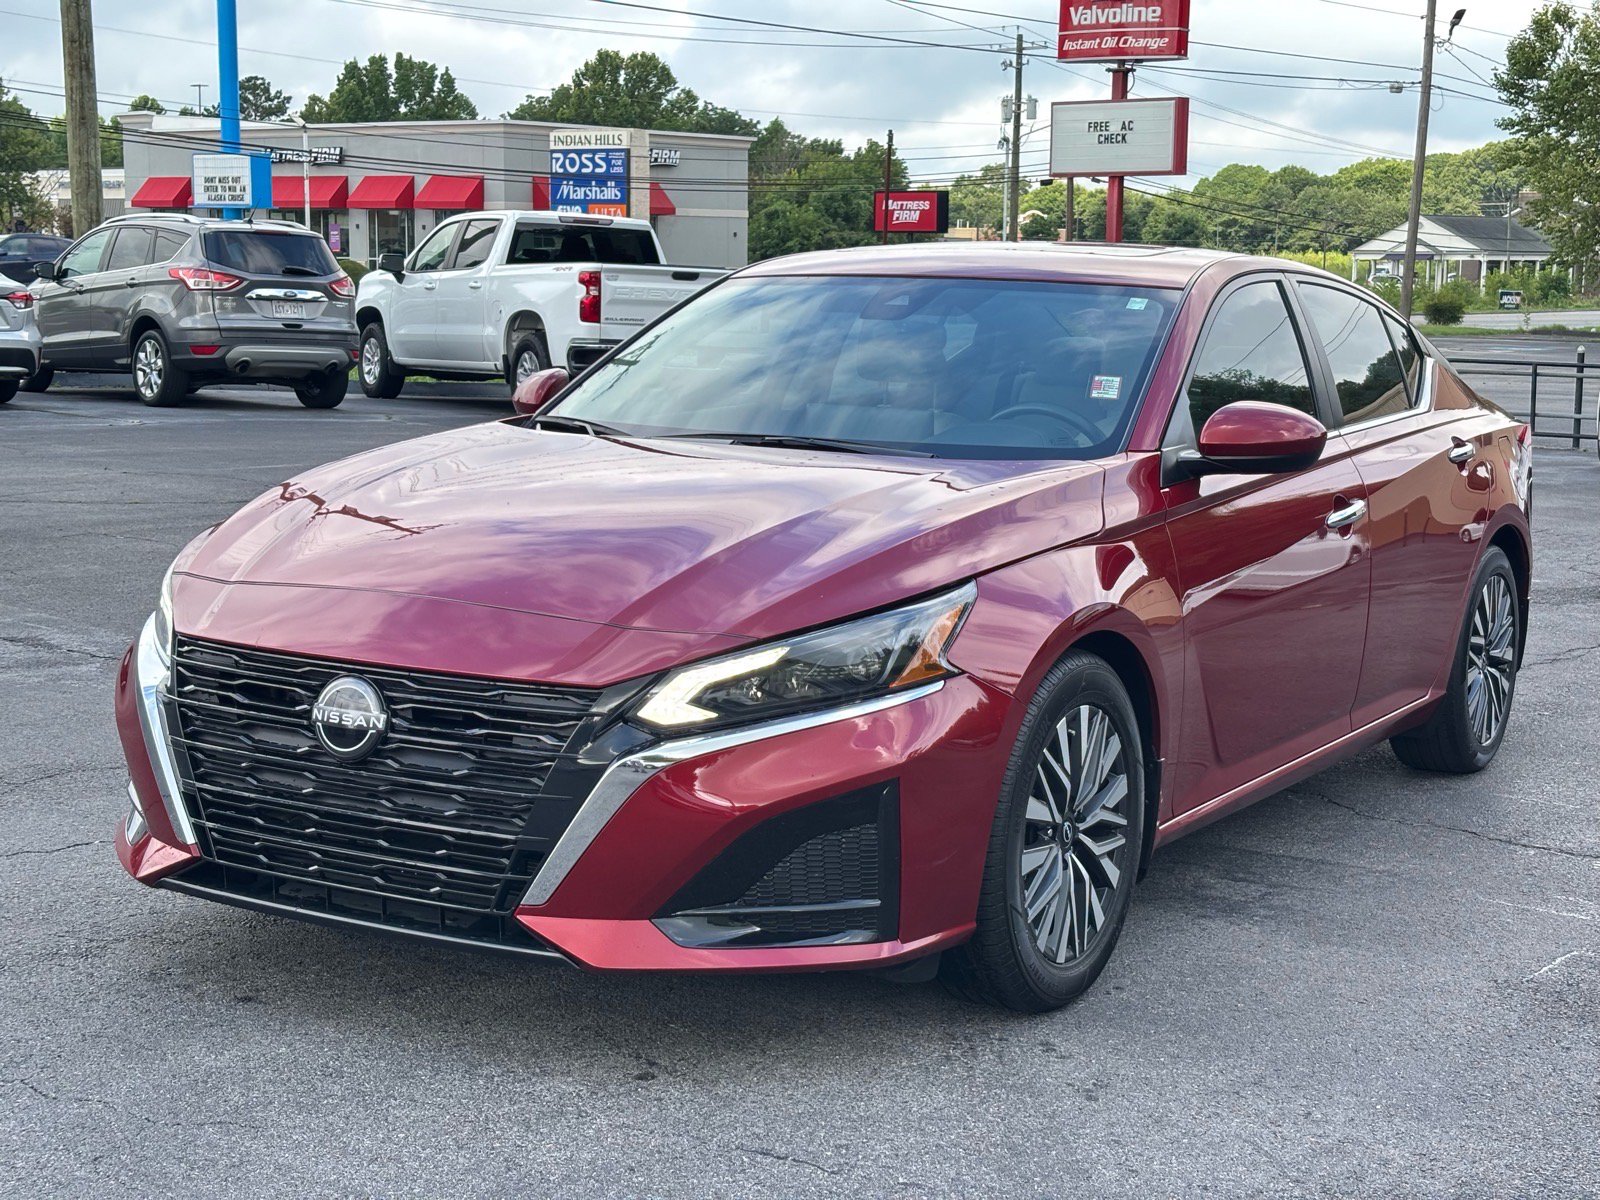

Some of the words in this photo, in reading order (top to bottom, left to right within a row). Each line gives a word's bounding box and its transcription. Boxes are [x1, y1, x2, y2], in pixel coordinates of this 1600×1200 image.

[1069, 3, 1161, 26] Valvoline
[1062, 37, 1100, 51] Instant
[1101, 36, 1116, 49] Oil
[1118, 35, 1169, 50] Change
[1087, 121, 1110, 133] FREE
[1120, 120, 1134, 131] AC
[553, 134, 592, 147] INDIAN
[594, 133, 623, 146] HILLS
[1097, 133, 1128, 145] CHECK
[552, 152, 607, 174] ROSS
[650, 149, 680, 164] FIRM
[556, 180, 621, 200] Marshalls
[892, 210, 921, 221] FIRM
[312, 707, 385, 729] NISSAN
